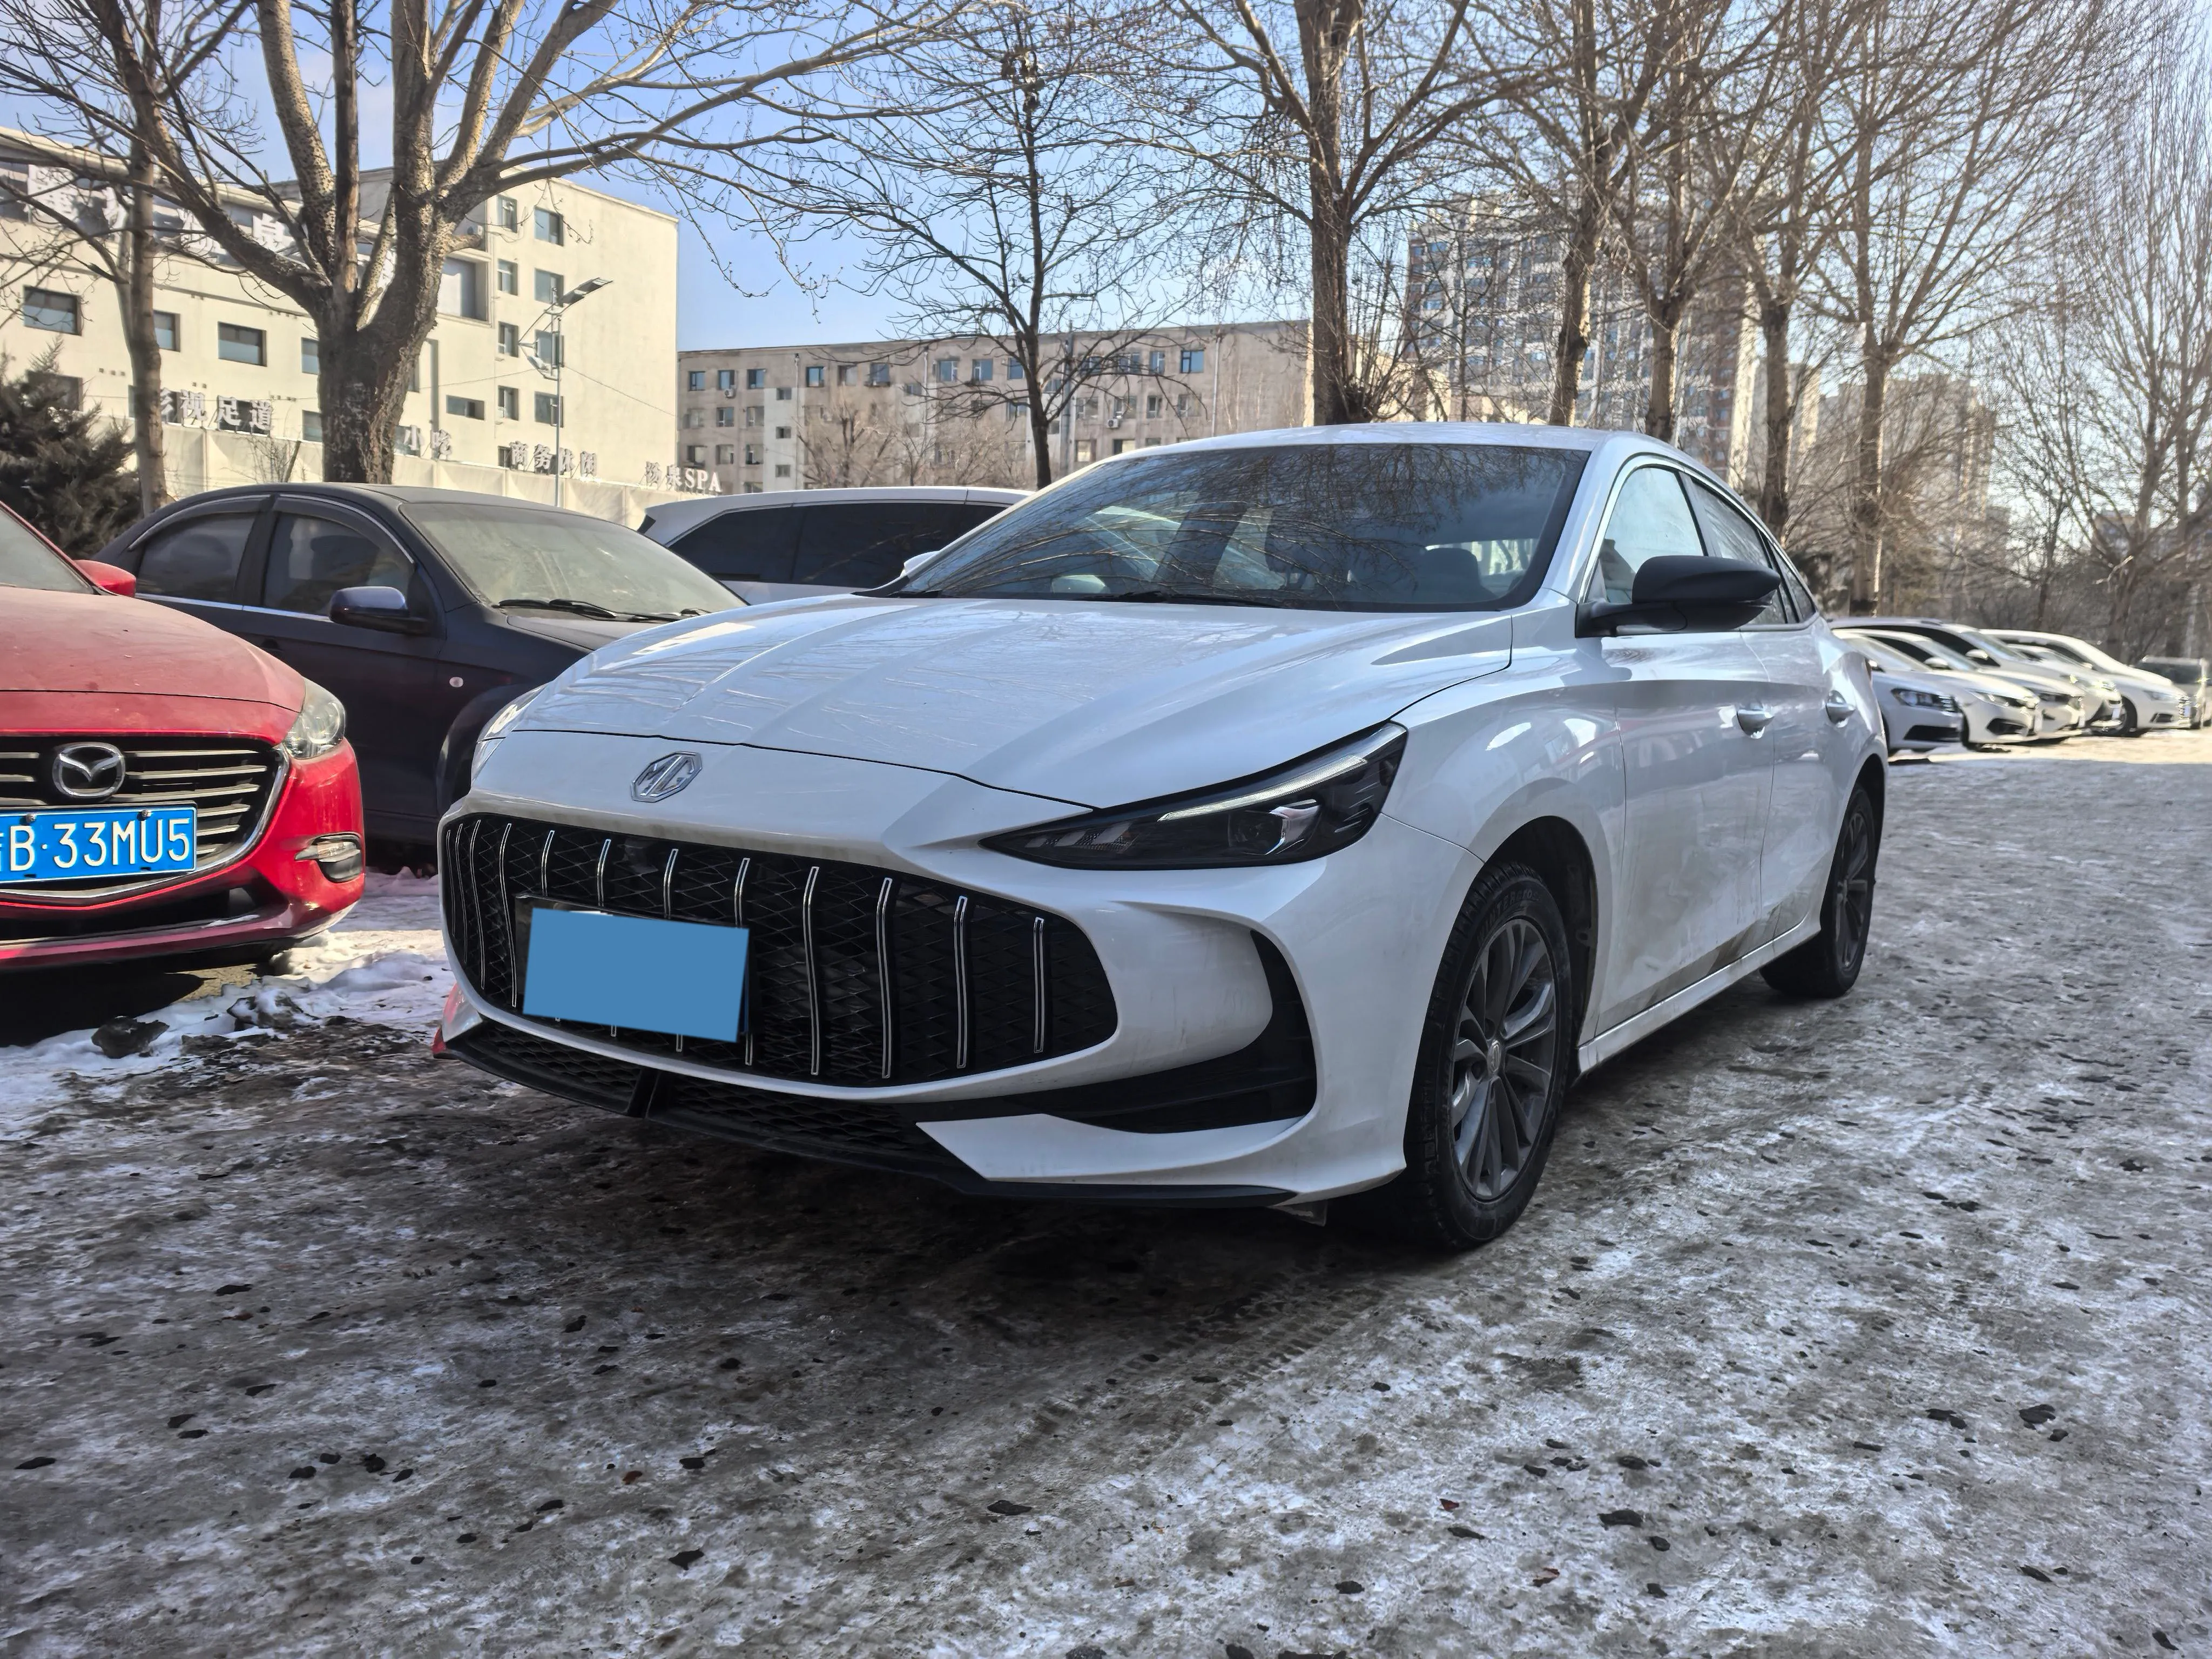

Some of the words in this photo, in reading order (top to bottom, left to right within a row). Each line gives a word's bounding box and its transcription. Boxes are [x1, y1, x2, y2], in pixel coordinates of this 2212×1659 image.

[403, 424, 453, 455] 小吃
[510, 441, 596, 476] 商务休闲
[635, 753, 699, 799] MG
[0, 818, 190, 871] B·33MU5
